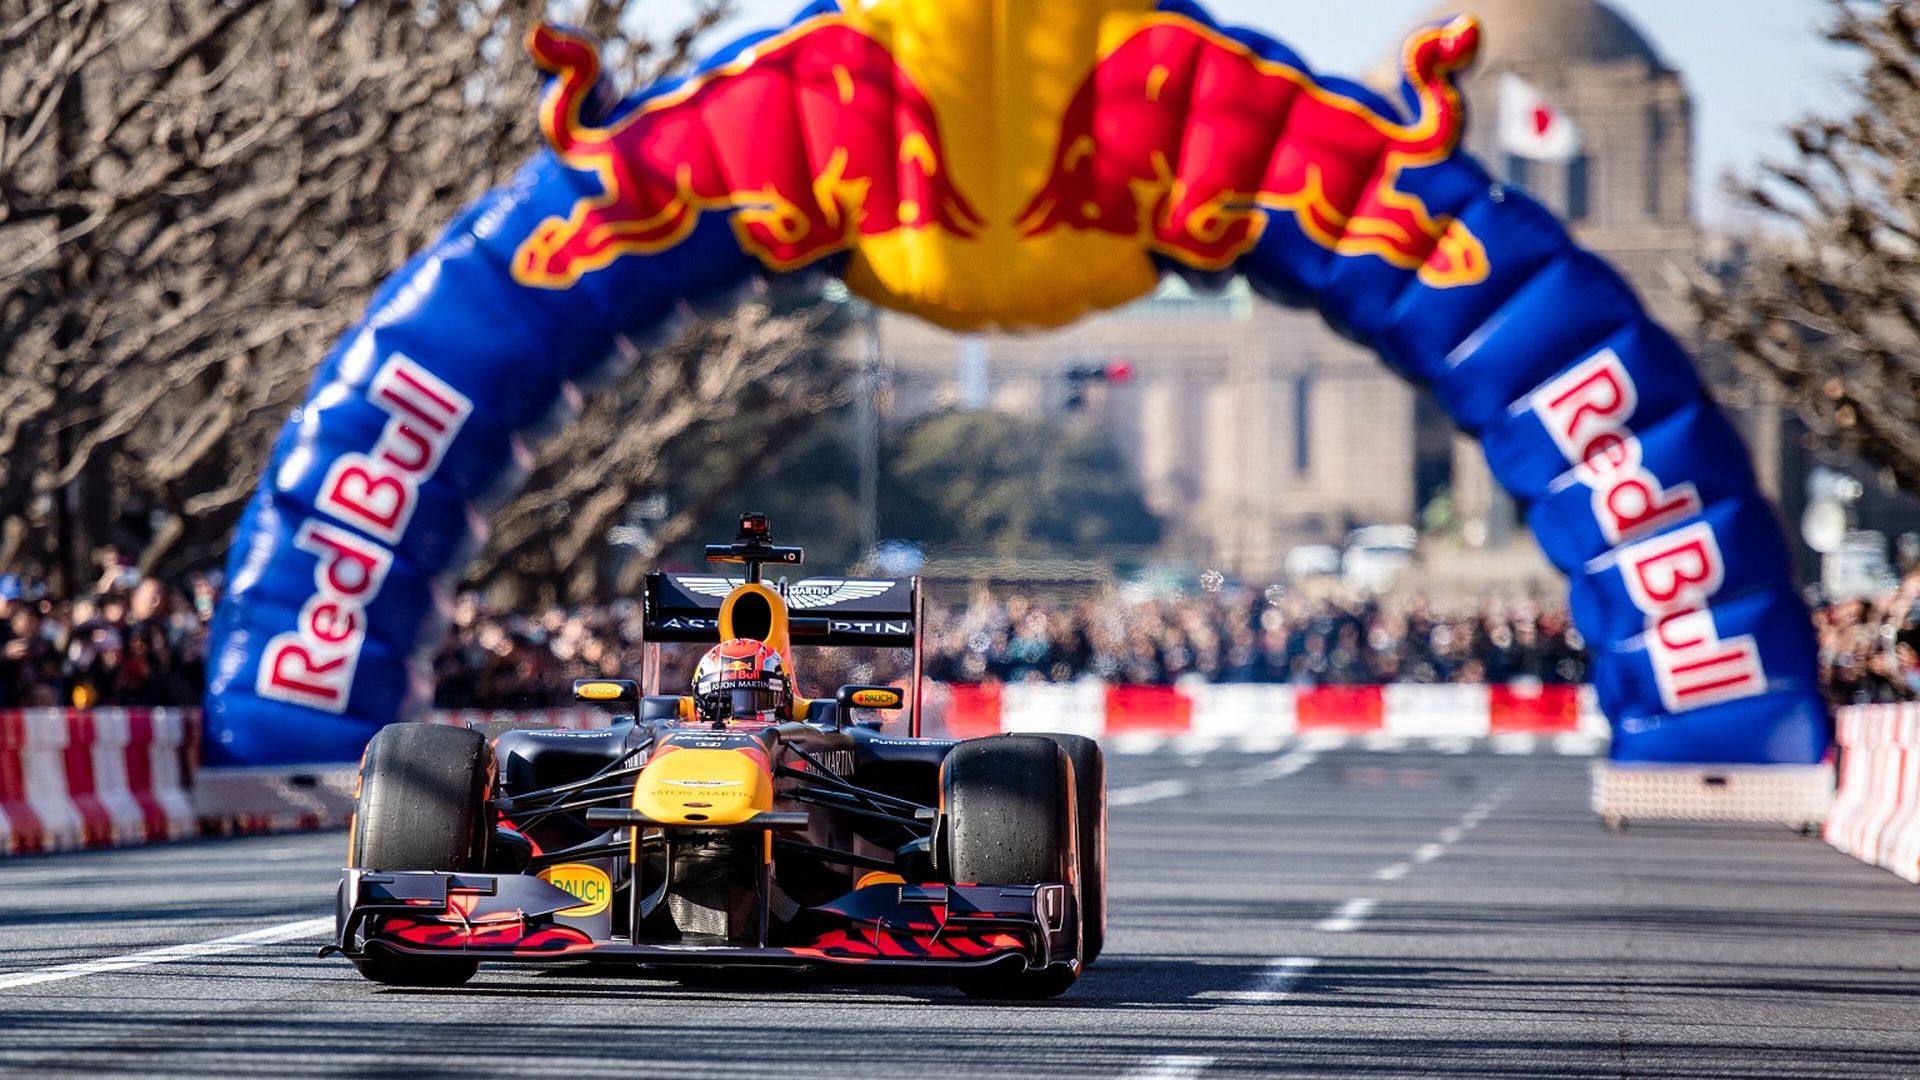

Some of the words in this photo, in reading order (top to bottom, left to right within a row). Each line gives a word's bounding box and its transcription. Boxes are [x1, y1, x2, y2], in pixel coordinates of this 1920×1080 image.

[323, 361, 465, 537] Bull
[1543, 358, 1695, 538] Red
[1627, 531, 1759, 704] Bull
[790, 586, 830, 595] MARTIN
[264, 526, 385, 706] Red
[738, 669, 760, 680] Bull
[738, 681, 769, 689] MARTIN
[864, 694, 893, 702] RAUCH
[1046, 889, 1054, 917] 1
